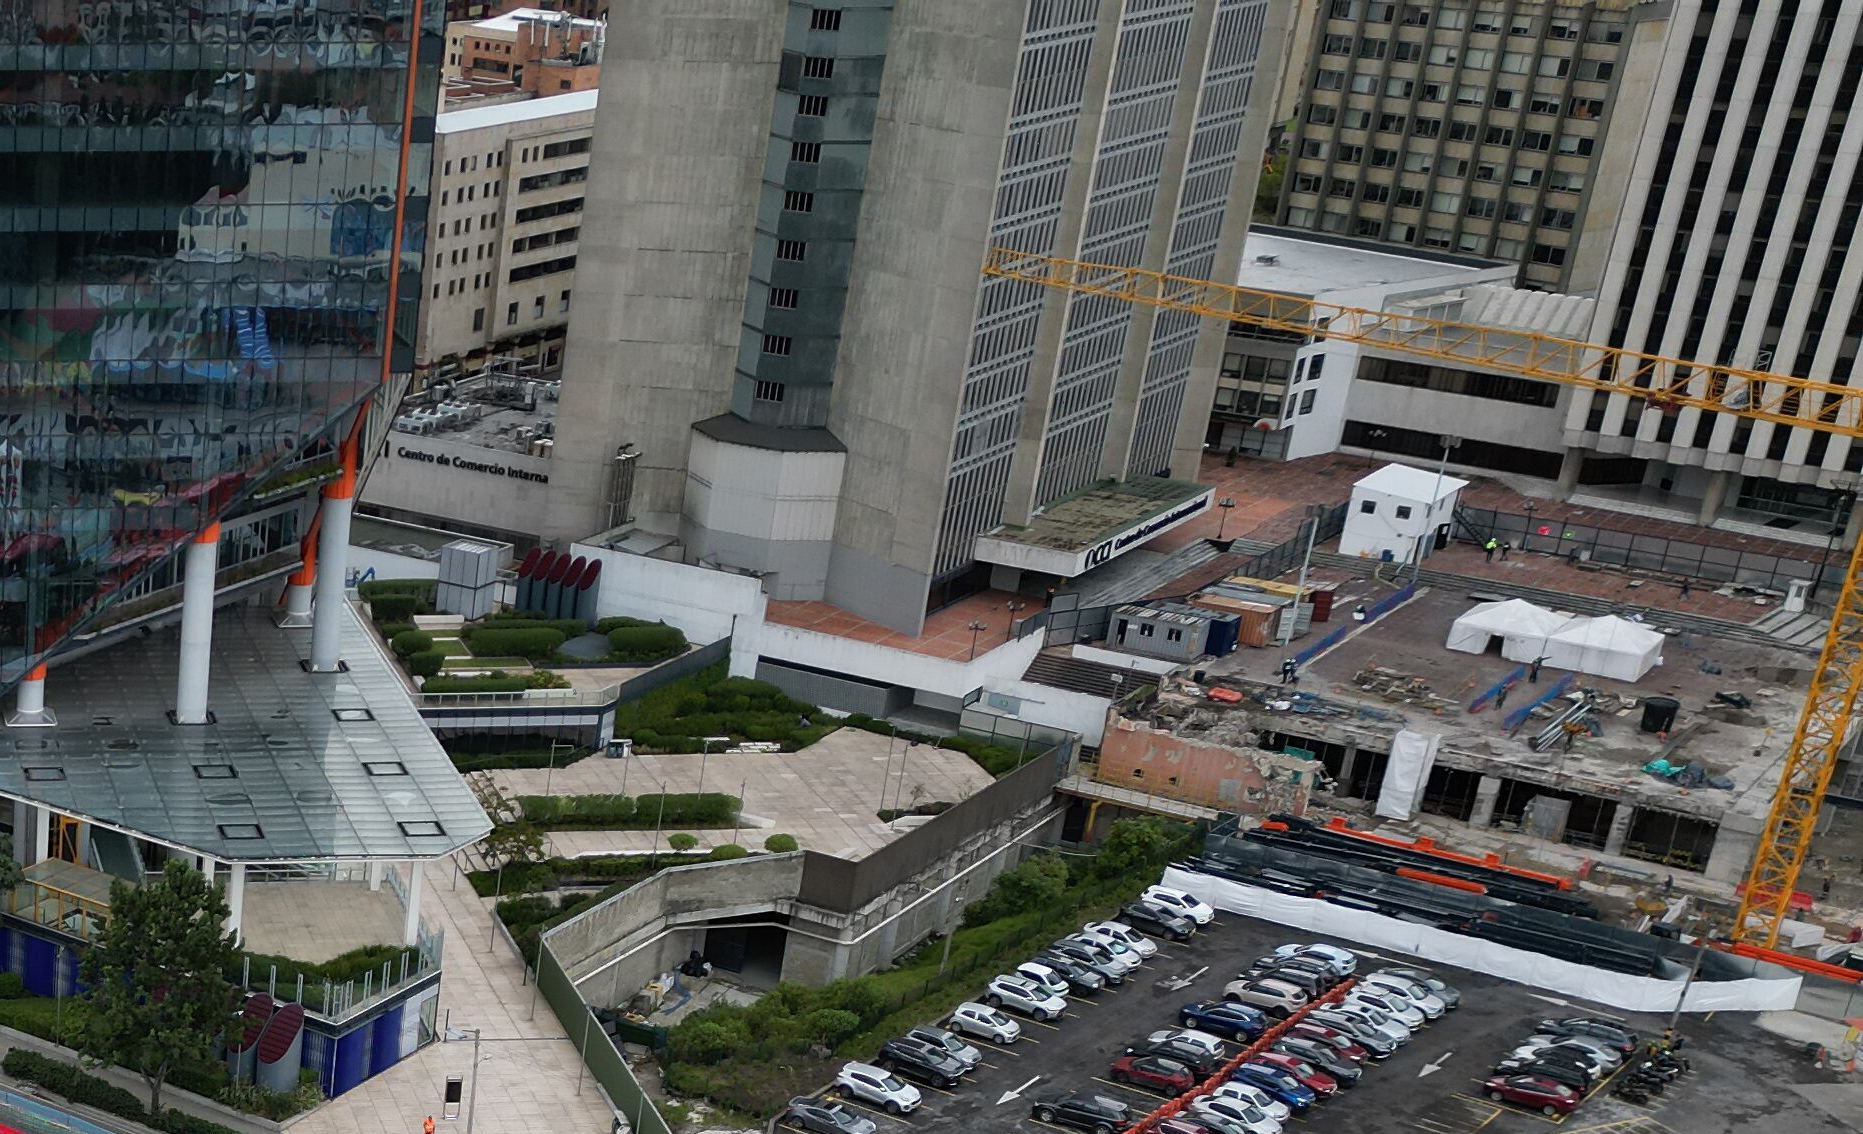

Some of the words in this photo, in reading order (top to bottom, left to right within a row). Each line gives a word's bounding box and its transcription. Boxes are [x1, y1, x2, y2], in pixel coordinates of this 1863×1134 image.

[397, 446, 435, 463] Centro
[437, 453, 450, 466] de
[453, 456, 505, 476] Comercio
